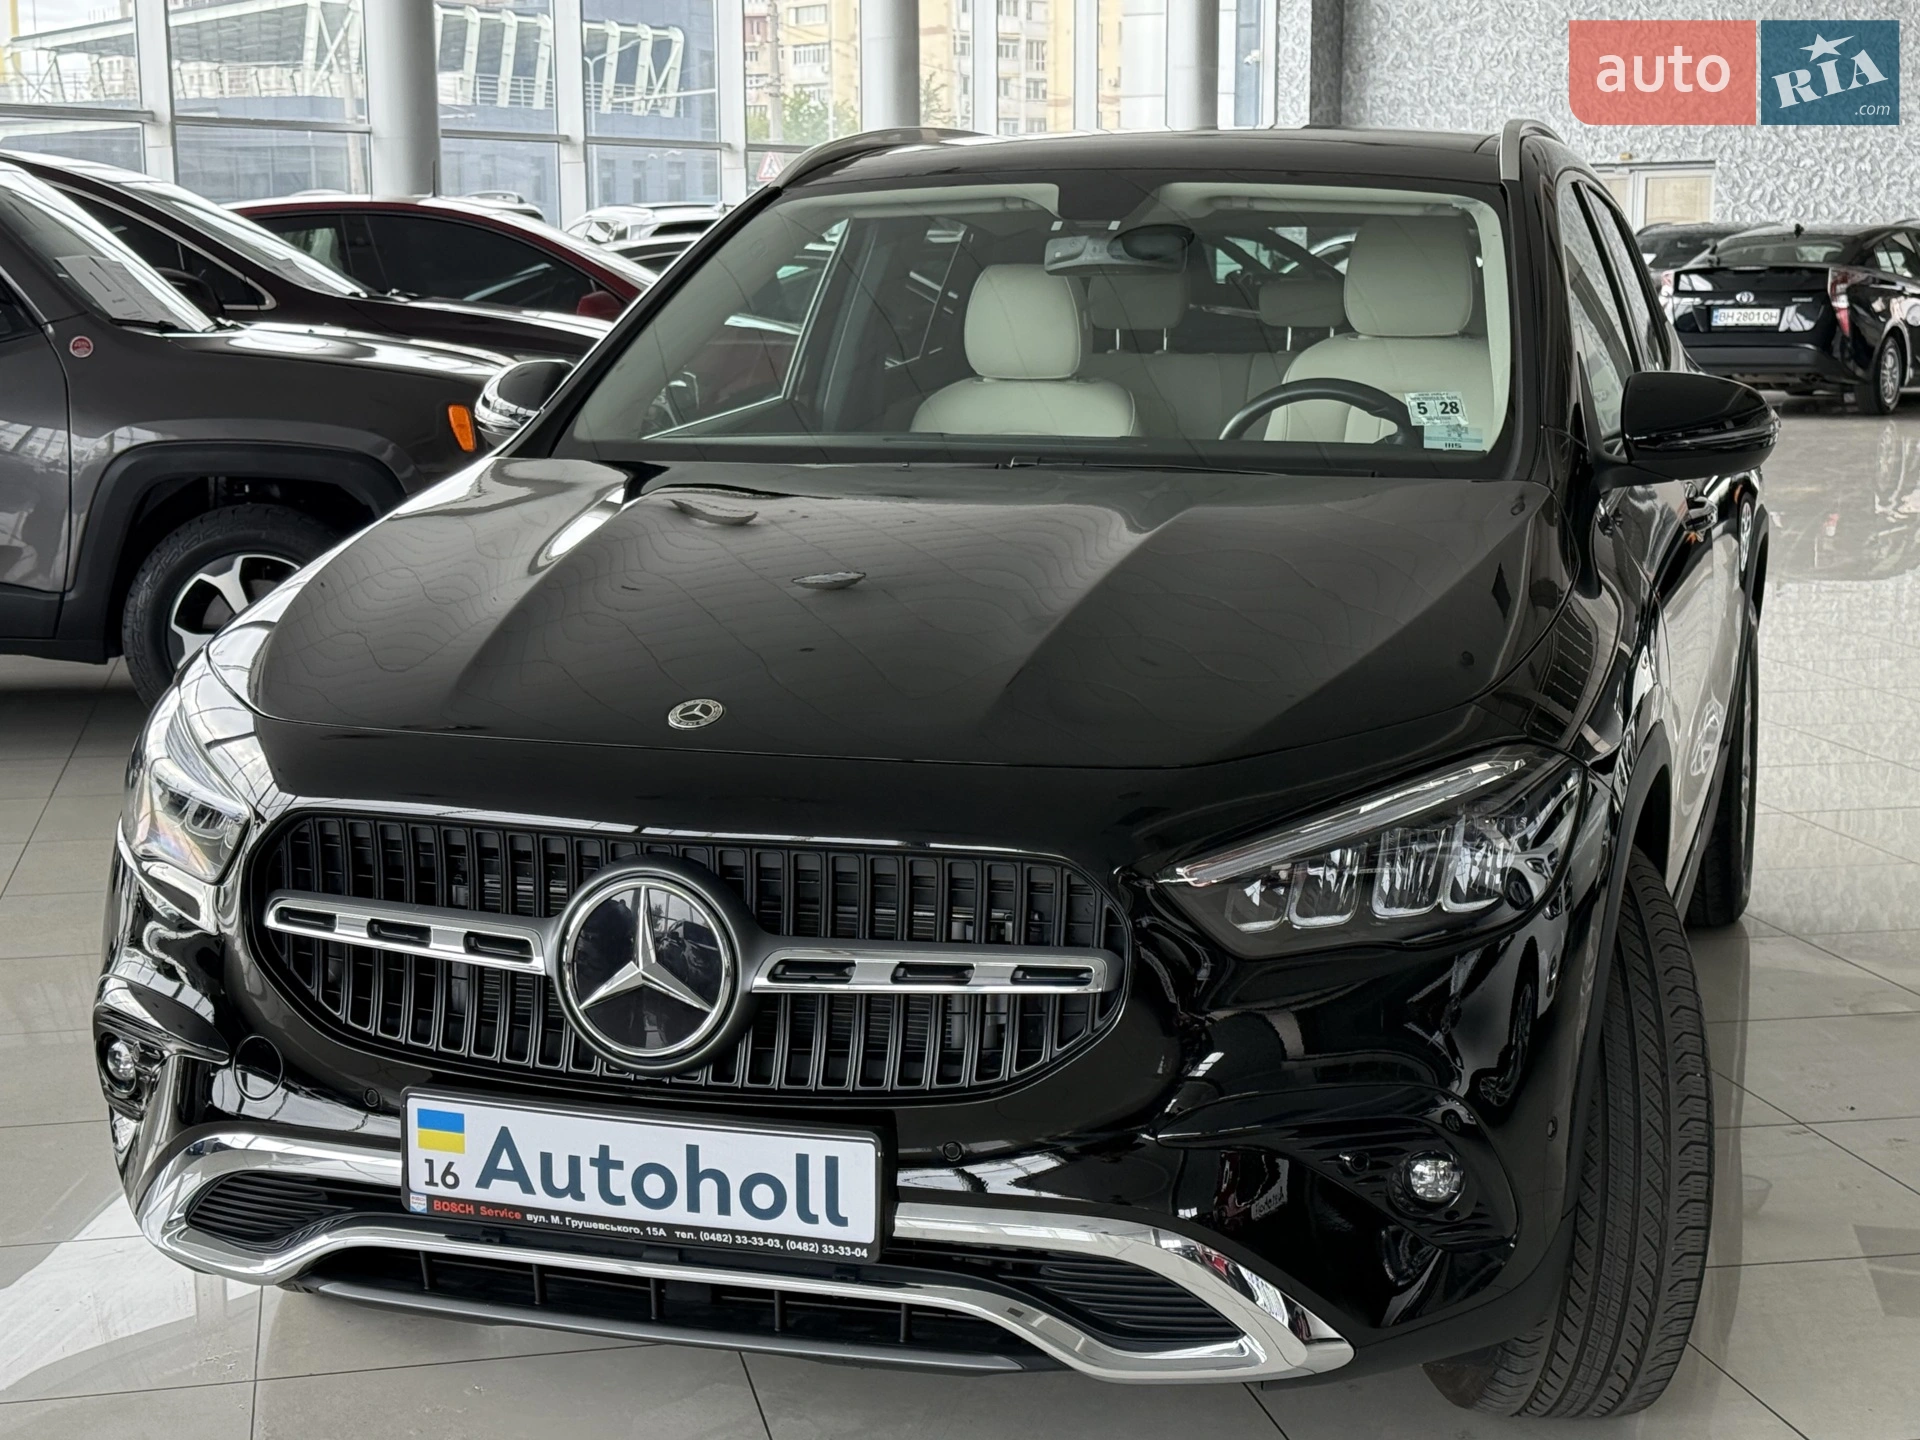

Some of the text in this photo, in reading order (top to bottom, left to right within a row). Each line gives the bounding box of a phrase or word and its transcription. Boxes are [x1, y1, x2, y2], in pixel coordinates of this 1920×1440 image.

[1719, 311, 1735, 322] BH
[1736, 311, 1760, 322] 2801
[1416, 401, 1460, 415] 5 28
[424, 1158, 461, 1190] 16
[475, 1126, 849, 1228] Autoholl
[433, 1200, 475, 1215] BOSCH
[479, 1206, 522, 1219] Service
[526, 1213, 549, 1224] вул.
[550, 1215, 563, 1226] М.
[565, 1217, 644, 1236] Грушевського,
[674, 1230, 697, 1240] тел.
[700, 1231, 732, 1244] (0482)
[735, 1234, 784, 1250] 33-33-03,
[786, 1239, 819, 1254] (0482)
[822, 1244, 868, 1258] 33-33-04
